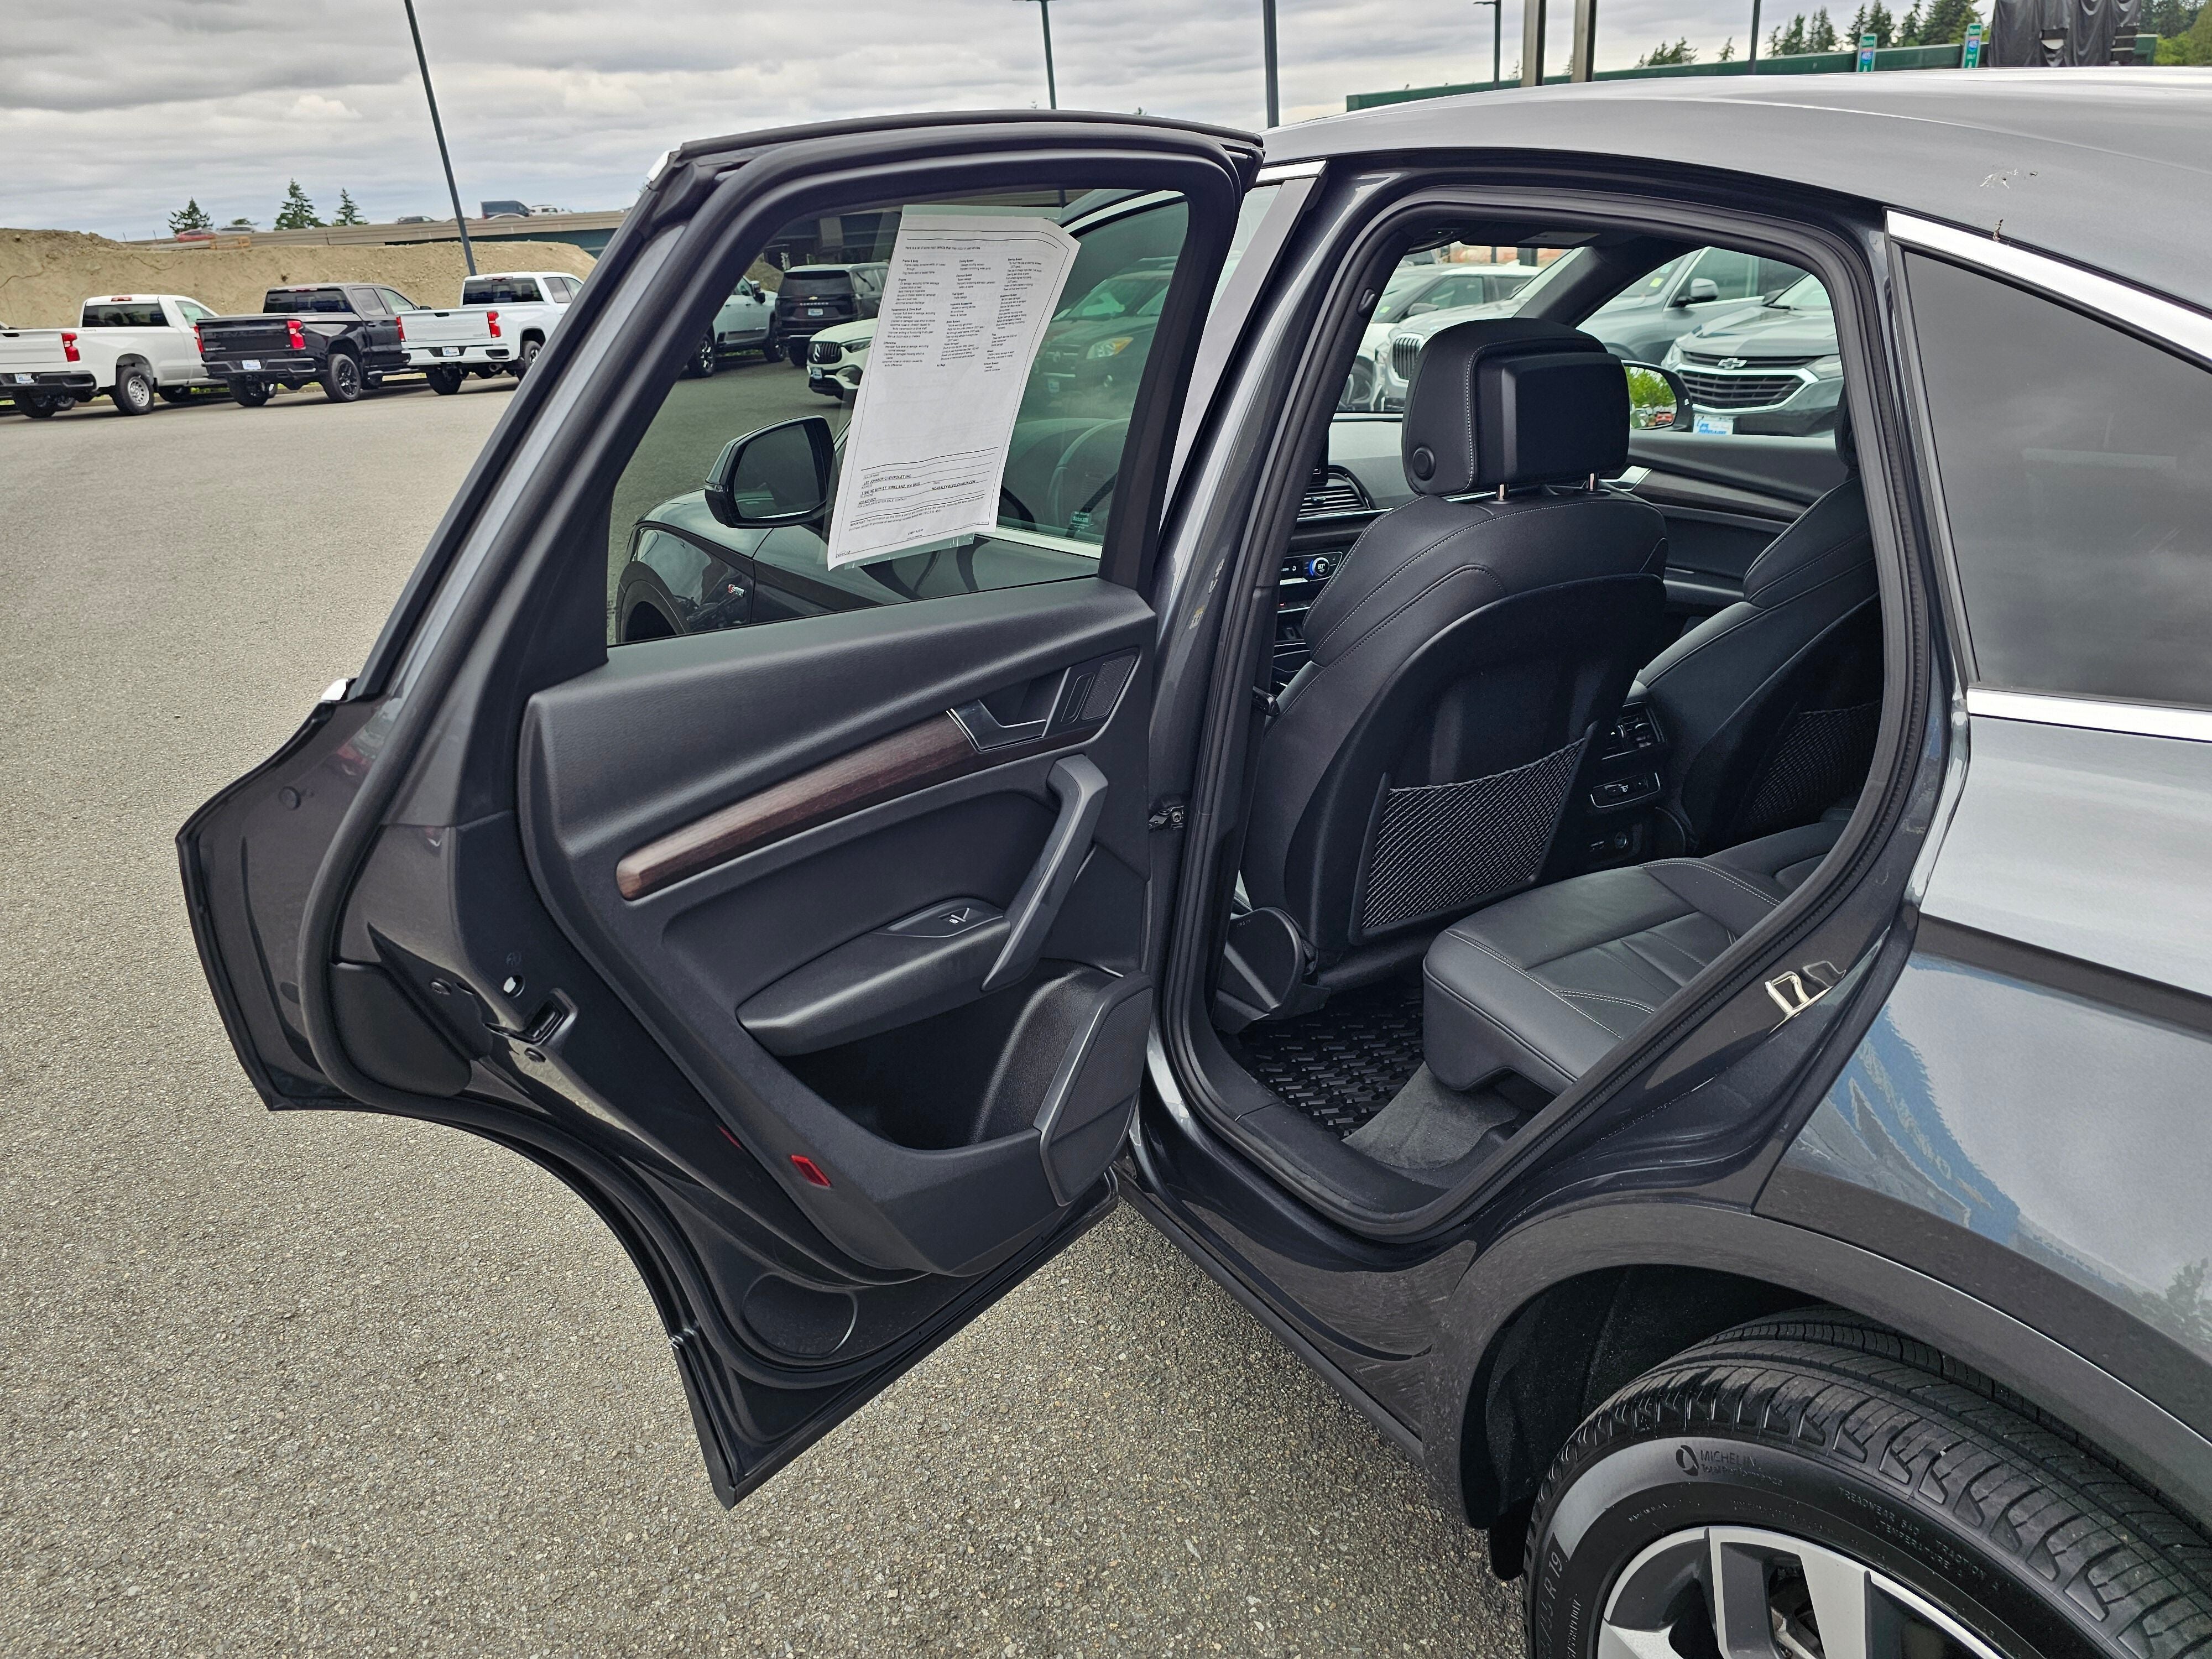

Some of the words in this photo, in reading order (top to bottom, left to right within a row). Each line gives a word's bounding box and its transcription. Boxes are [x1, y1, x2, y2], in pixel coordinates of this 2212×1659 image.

[1700, 1449, 1756, 1467] MICHELIN
[1701, 1464, 1720, 1474] Total
[1838, 1486, 1896, 1522] TREADWEAR
[1935, 1540, 1987, 1580] TRACTION
[1548, 1551, 1563, 1579] 19
[1544, 1577, 1557, 1600] R
